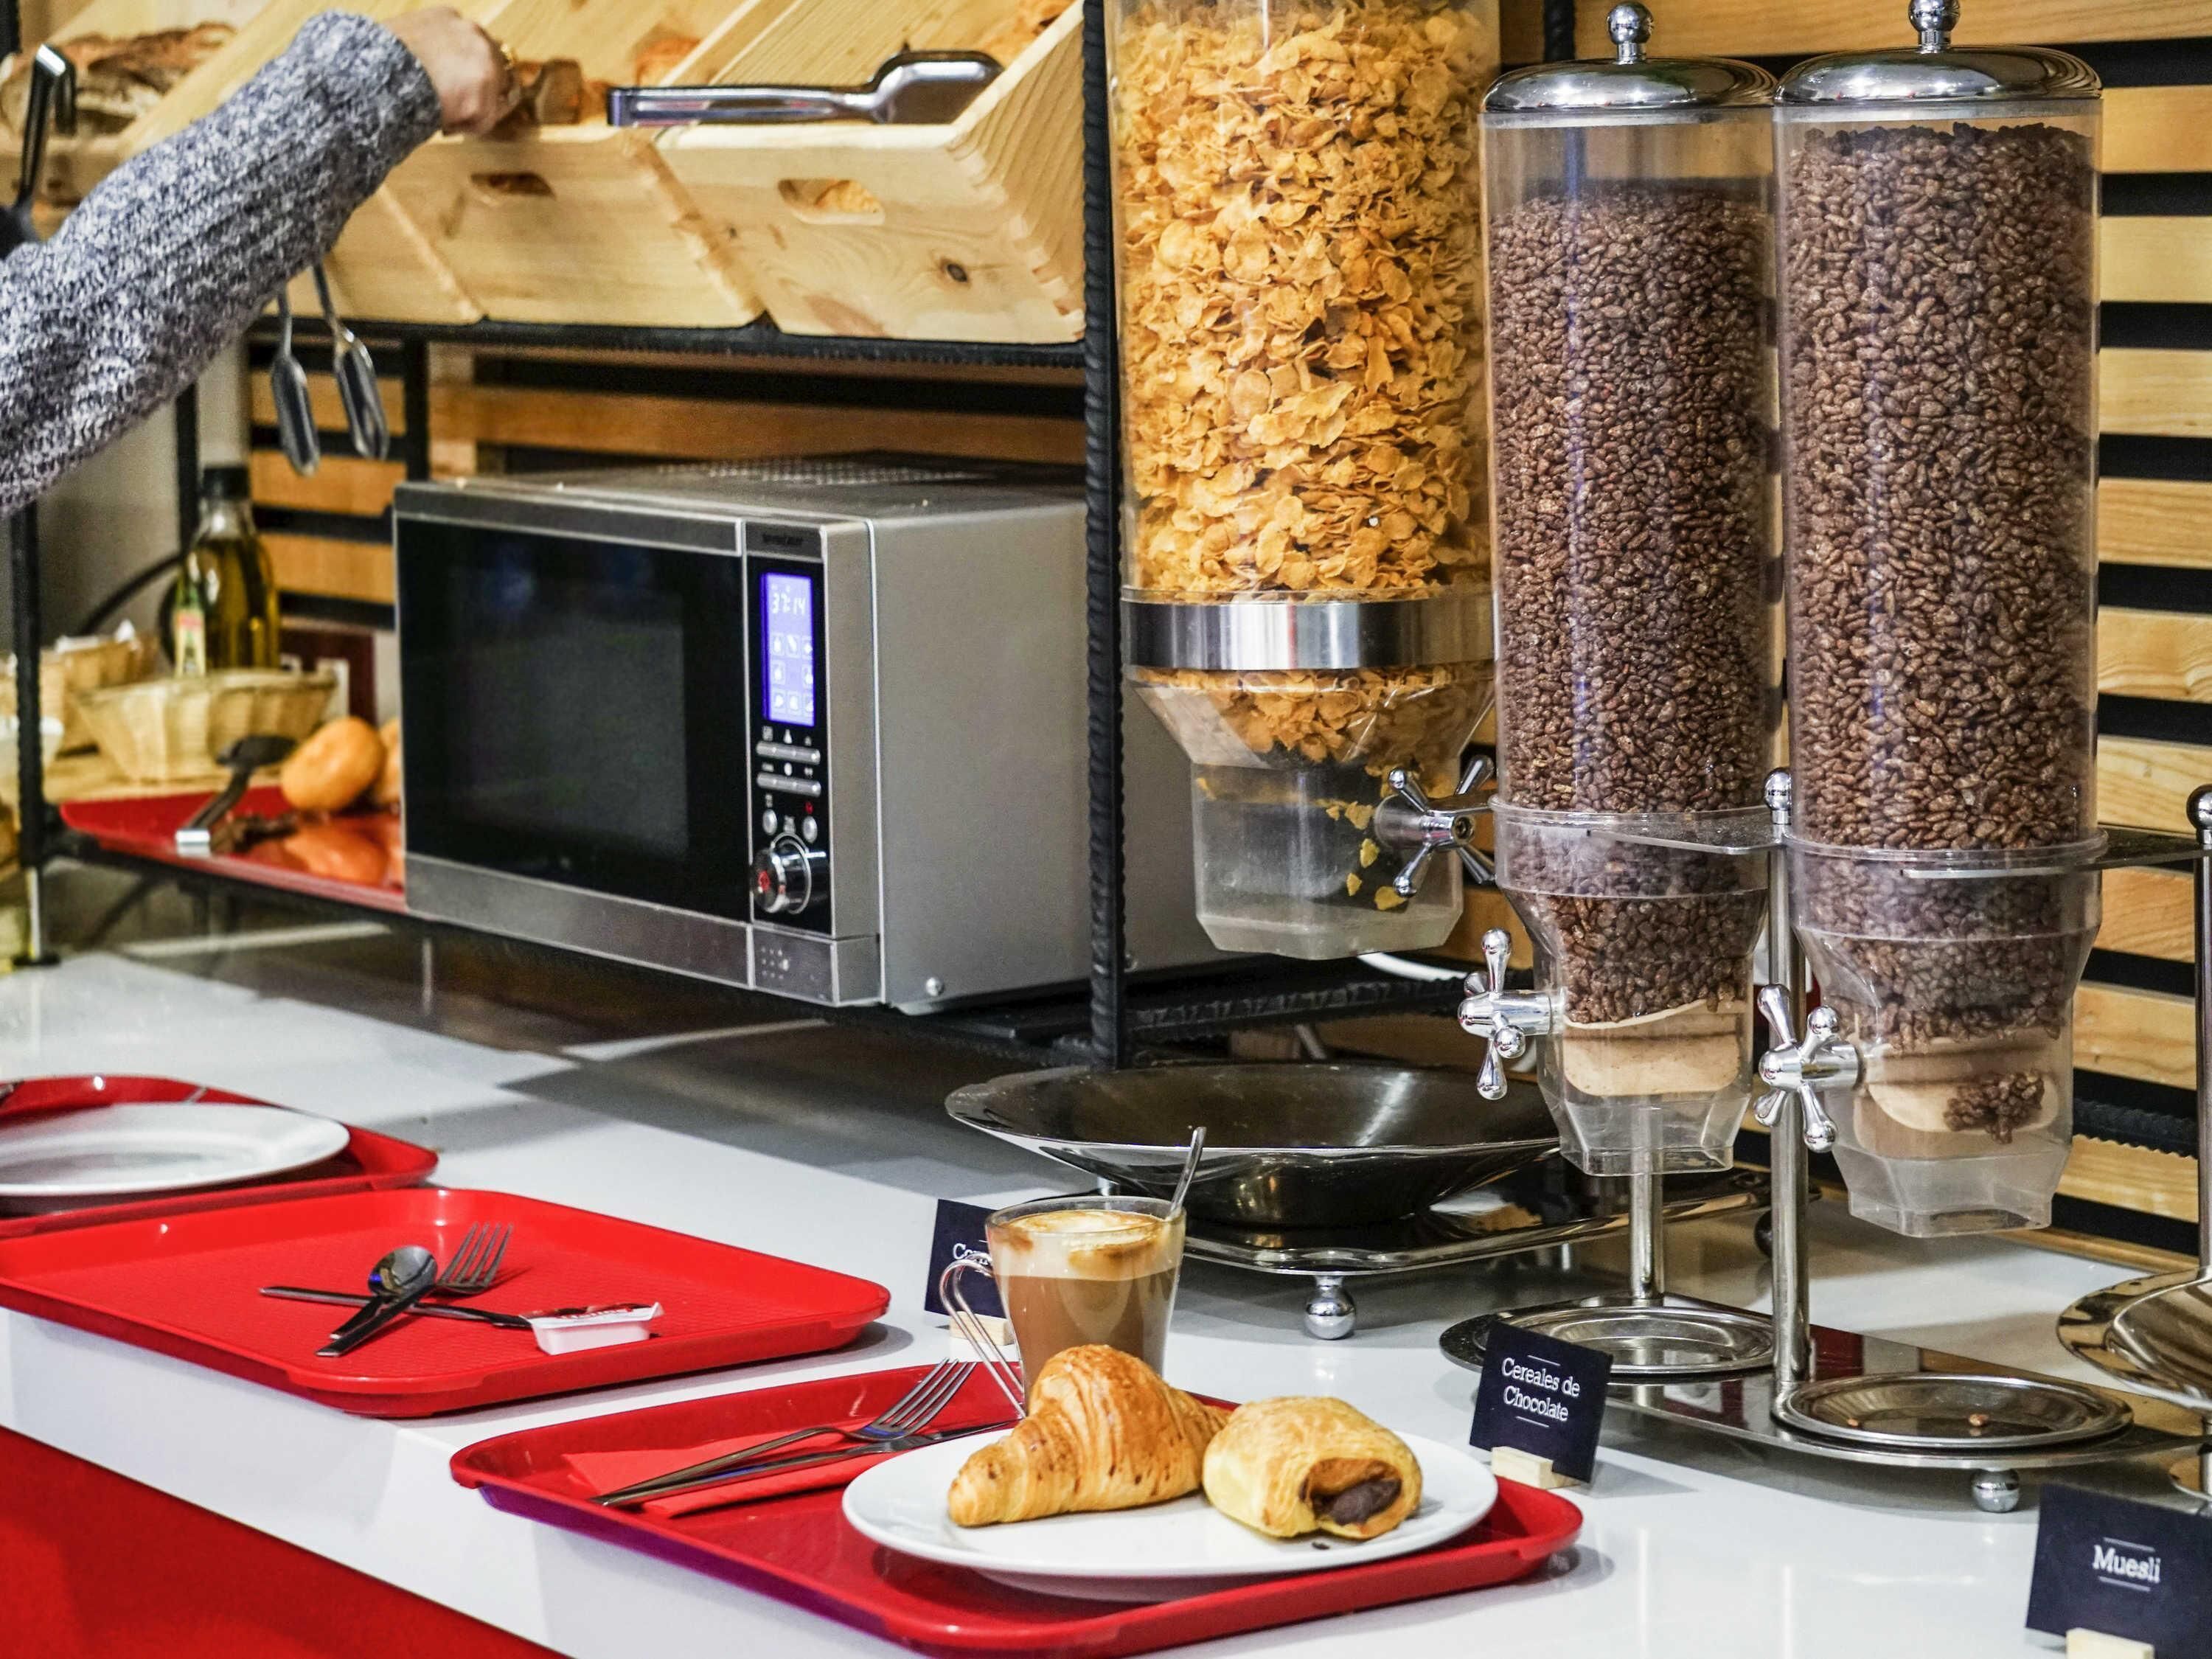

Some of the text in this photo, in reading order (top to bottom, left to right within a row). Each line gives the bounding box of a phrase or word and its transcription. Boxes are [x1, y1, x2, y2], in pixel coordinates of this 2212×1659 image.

[1501, 1357, 1581, 1397] Cereales de
[1503, 1385, 1569, 1422] Chocolate
[2092, 1545, 2161, 1583] Muesli
